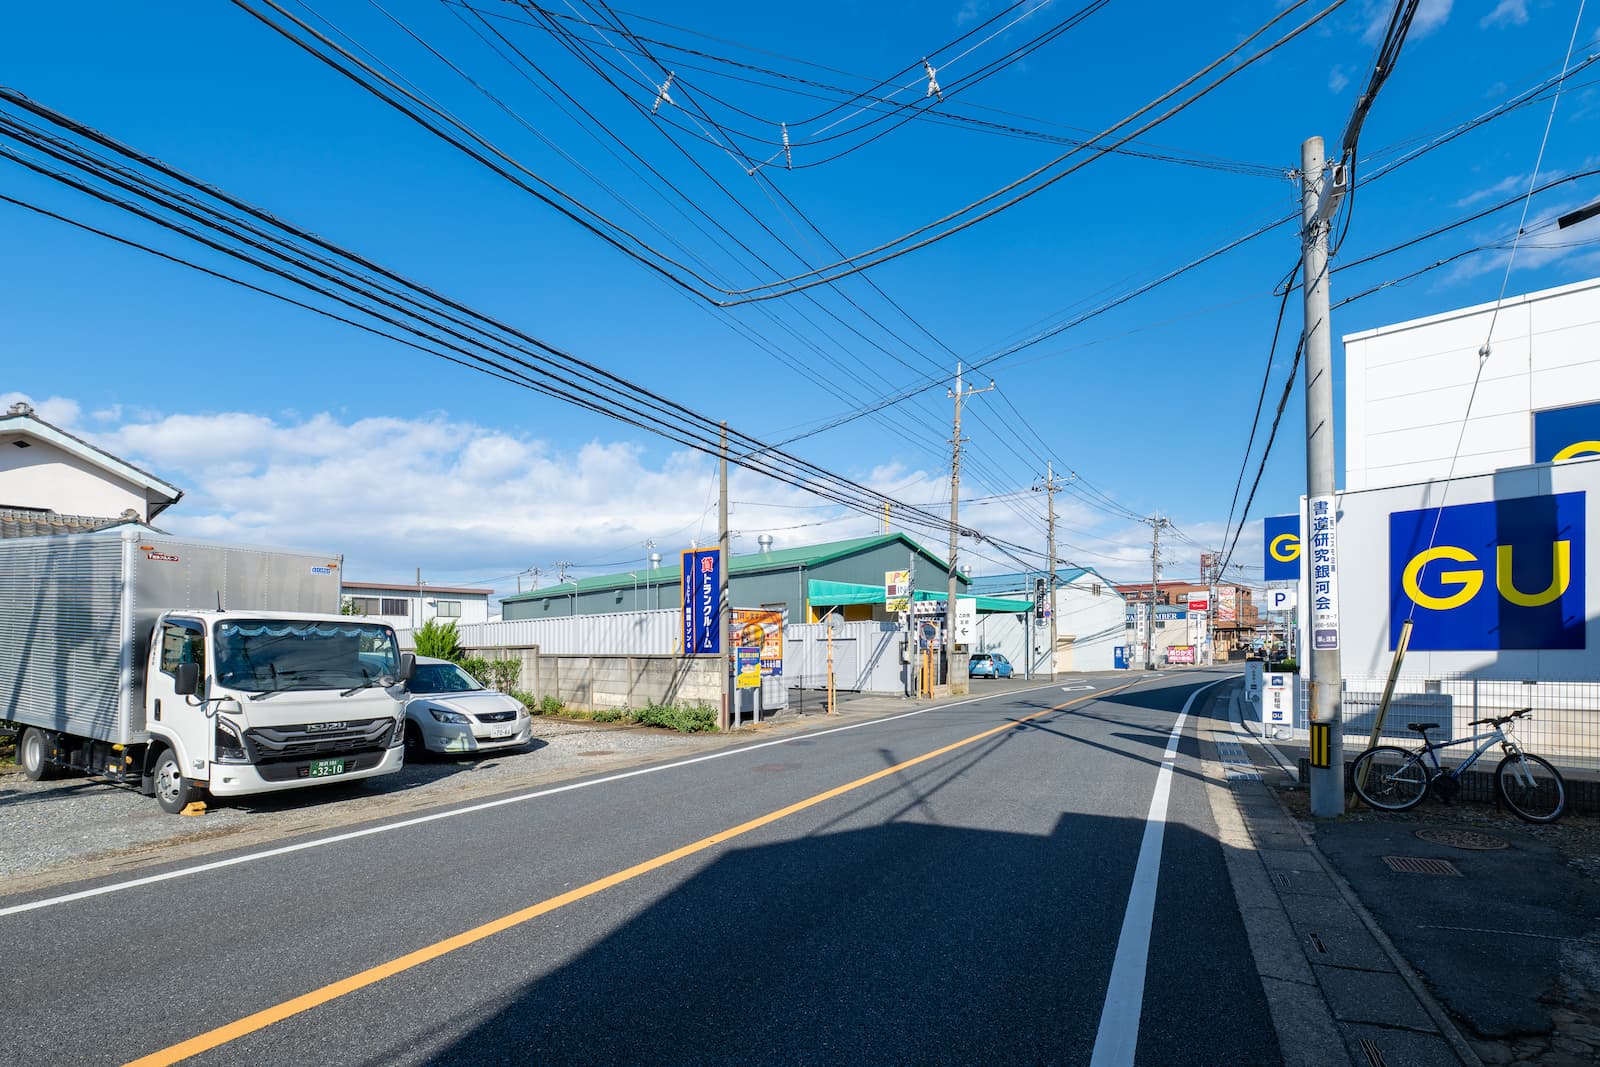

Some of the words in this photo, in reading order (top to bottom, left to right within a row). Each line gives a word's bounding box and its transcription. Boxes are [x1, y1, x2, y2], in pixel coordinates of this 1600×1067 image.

[1314, 501, 1330, 610] 書道研究銀河会
[1402, 540, 1571, 610] GU
[701, 557, 714, 648] 貸トランクルーム
[1274, 592, 1286, 607] P
[307, 722, 347, 732] ISUZU
[318, 765, 343, 776] 32-10
